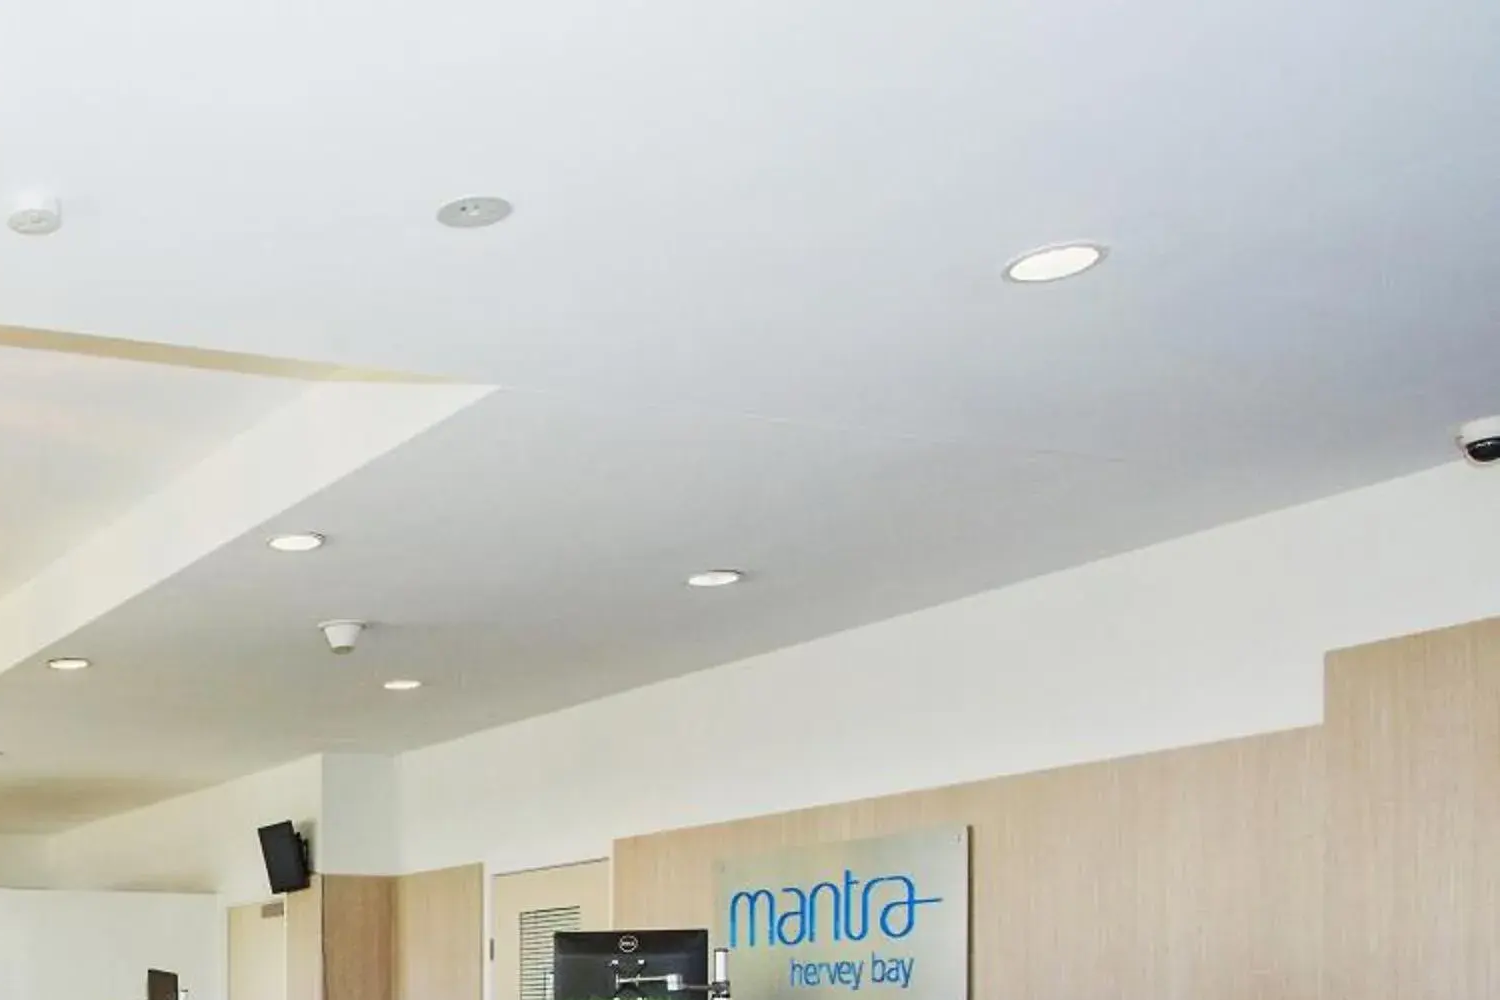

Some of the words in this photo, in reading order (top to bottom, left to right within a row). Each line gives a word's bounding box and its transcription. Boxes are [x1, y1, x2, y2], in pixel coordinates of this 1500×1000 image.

[729, 869, 943, 948] mantra
[790, 956, 863, 991] hervey
[871, 951, 915, 989] bay
